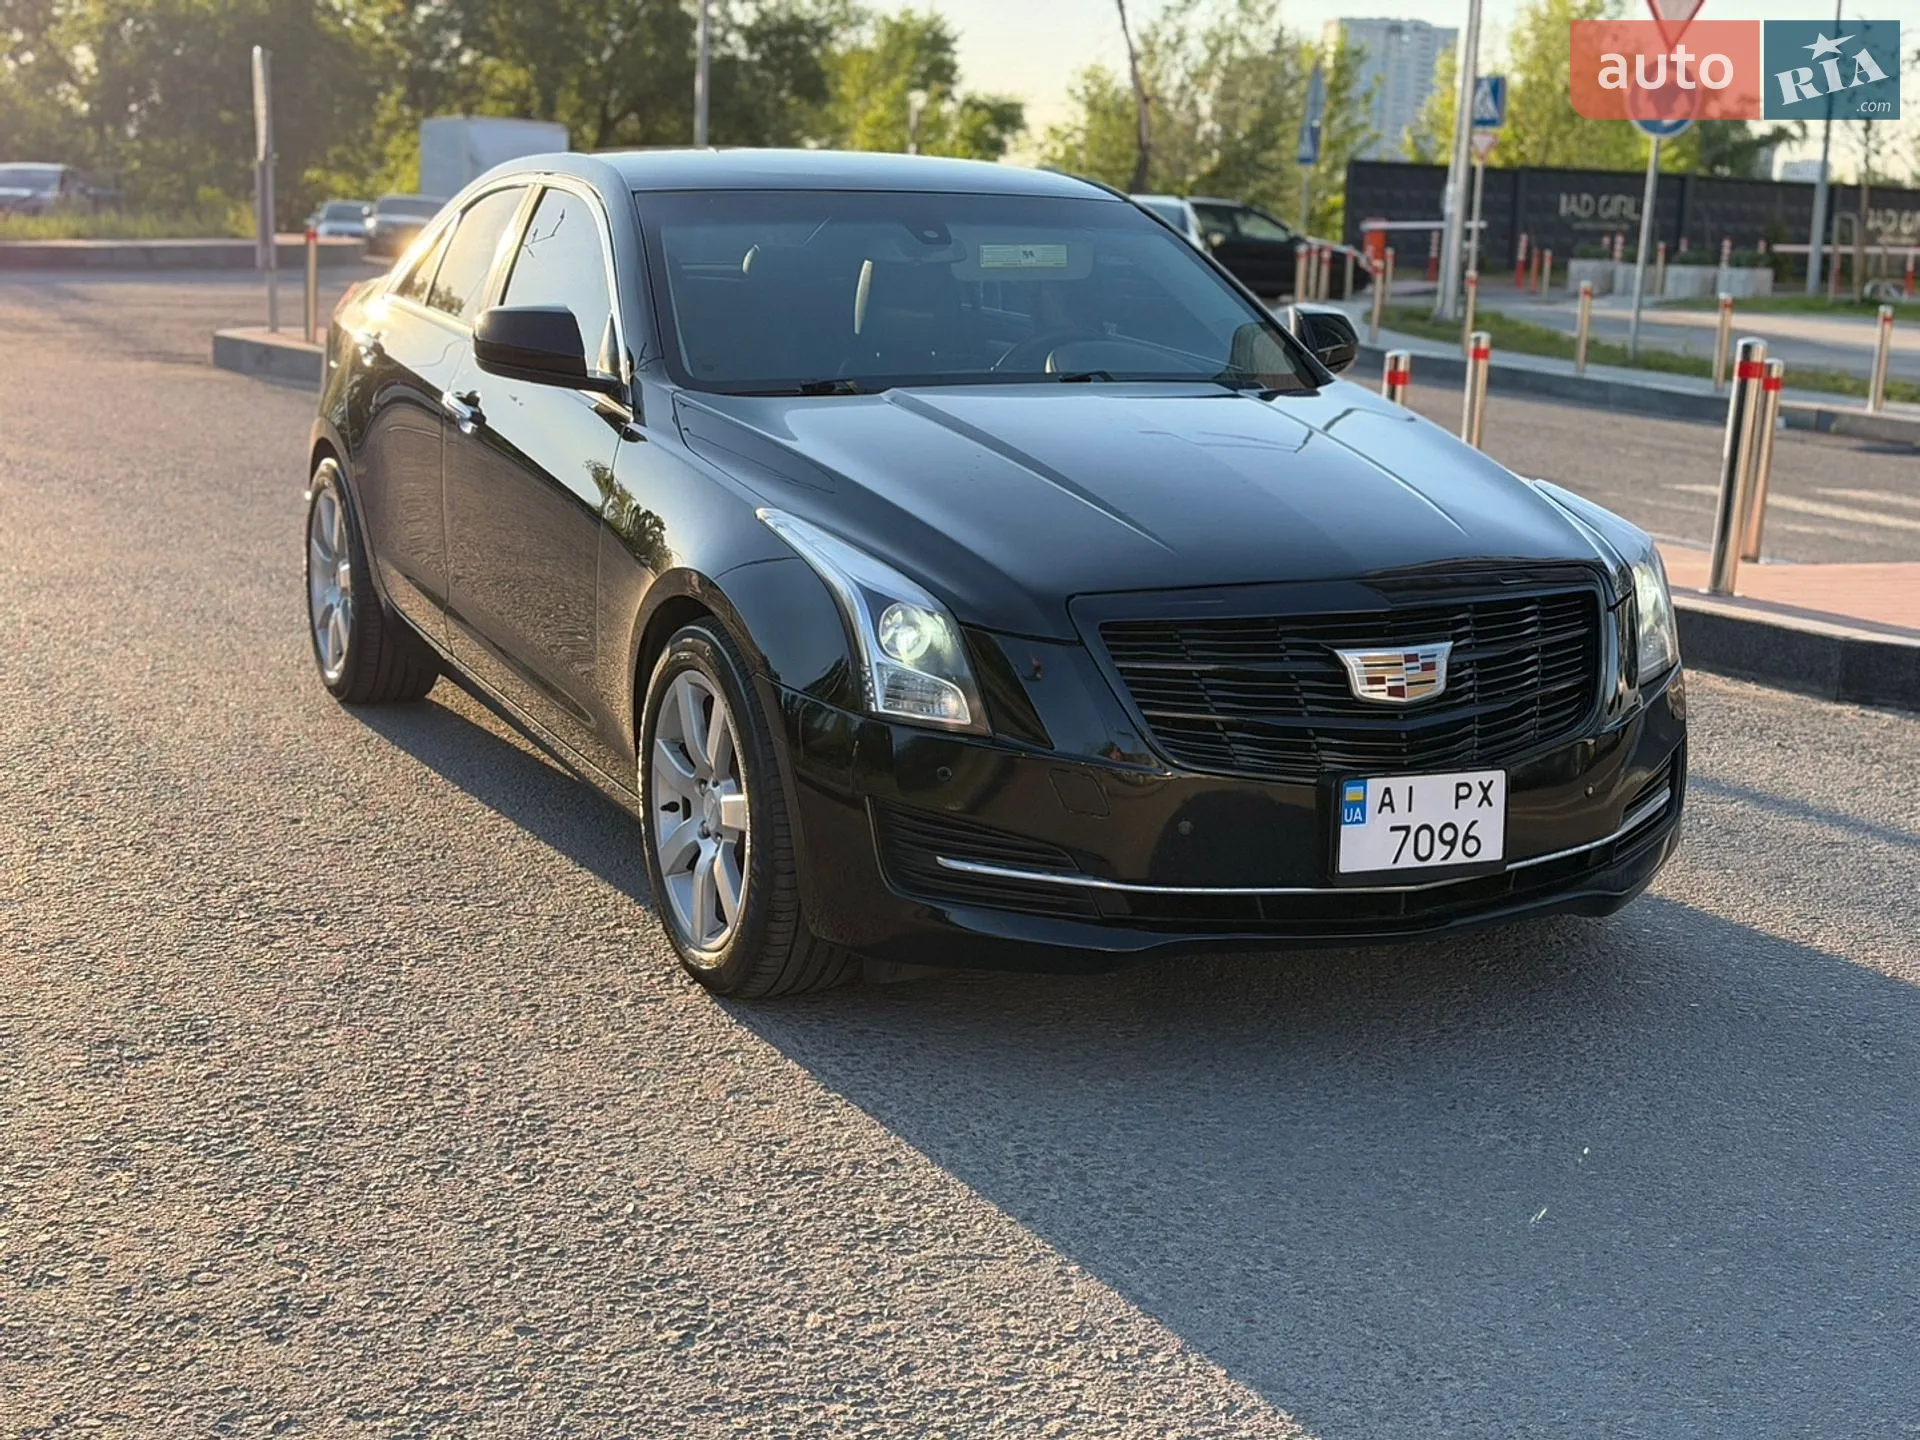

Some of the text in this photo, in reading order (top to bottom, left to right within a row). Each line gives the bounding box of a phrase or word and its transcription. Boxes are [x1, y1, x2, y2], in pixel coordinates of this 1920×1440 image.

[1377, 779, 1494, 814] AI PX
[1344, 807, 1363, 823] UA
[1389, 819, 1482, 865] 7096
